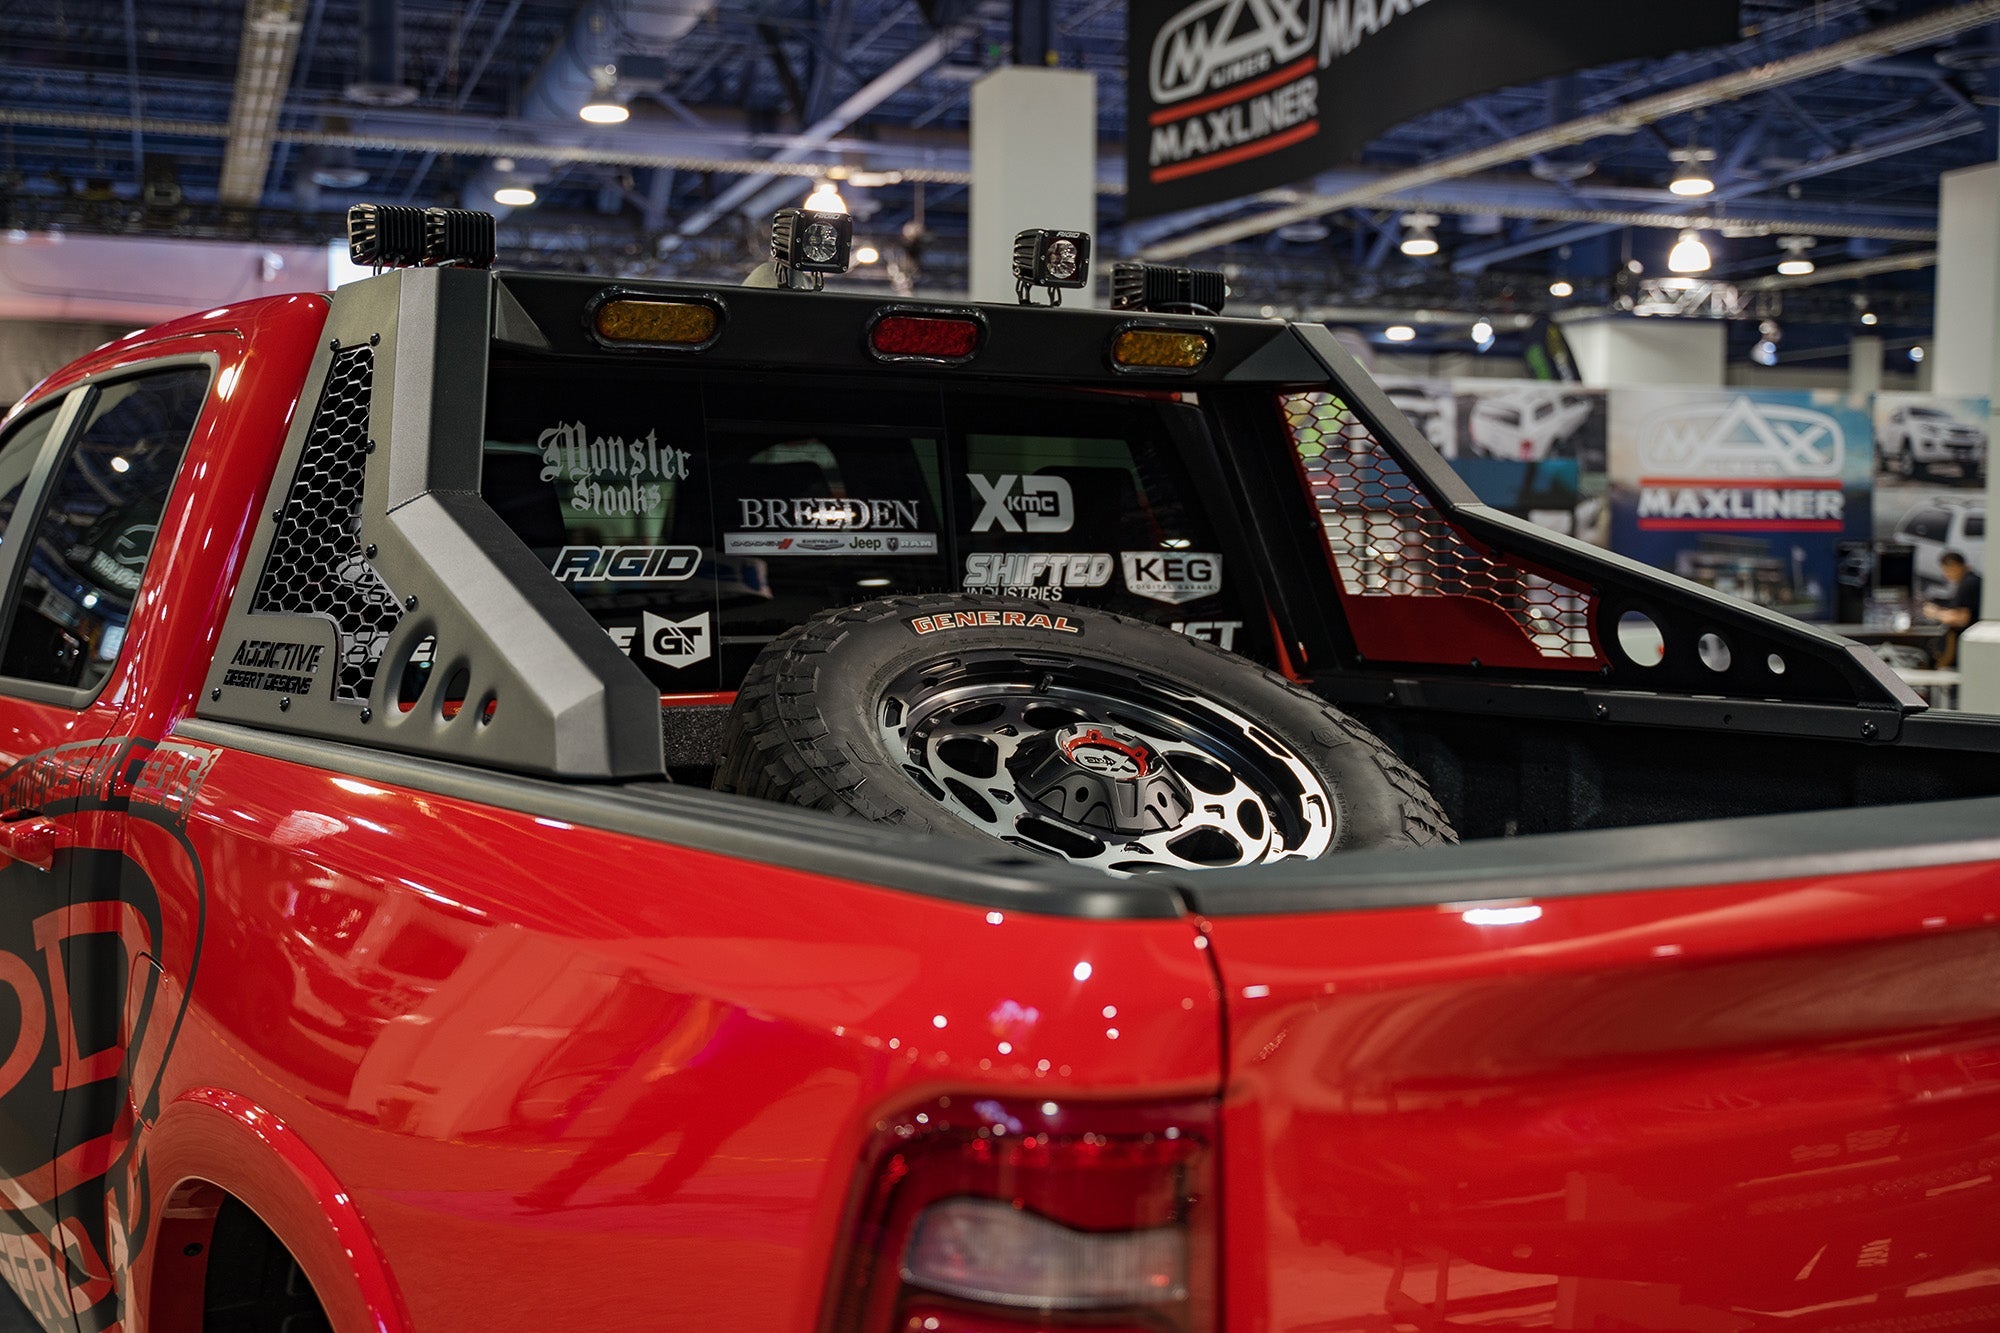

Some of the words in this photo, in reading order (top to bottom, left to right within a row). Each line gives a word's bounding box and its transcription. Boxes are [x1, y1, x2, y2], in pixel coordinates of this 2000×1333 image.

[1150, 76, 1319, 166] MAXLINER
[1648, 396, 1834, 471] MAX
[537, 420, 691, 482] Monster
[738, 498, 919, 529] BREEDEN
[1637, 488, 1845, 519] MAXLINER
[850, 536, 881, 550] Jeep
[901, 540, 932, 548] RAM
[551, 546, 703, 581] RIGID
[963, 553, 1114, 587] SHIFTED
[1135, 558, 1212, 582] KEG
[911, 611, 1079, 635] GENERAL
[653, 626, 703, 655] GT
[231, 640, 325, 673] ADDICTIVE
[223, 668, 265, 689] DESERT
[263, 673, 312, 695] DESIGNS
